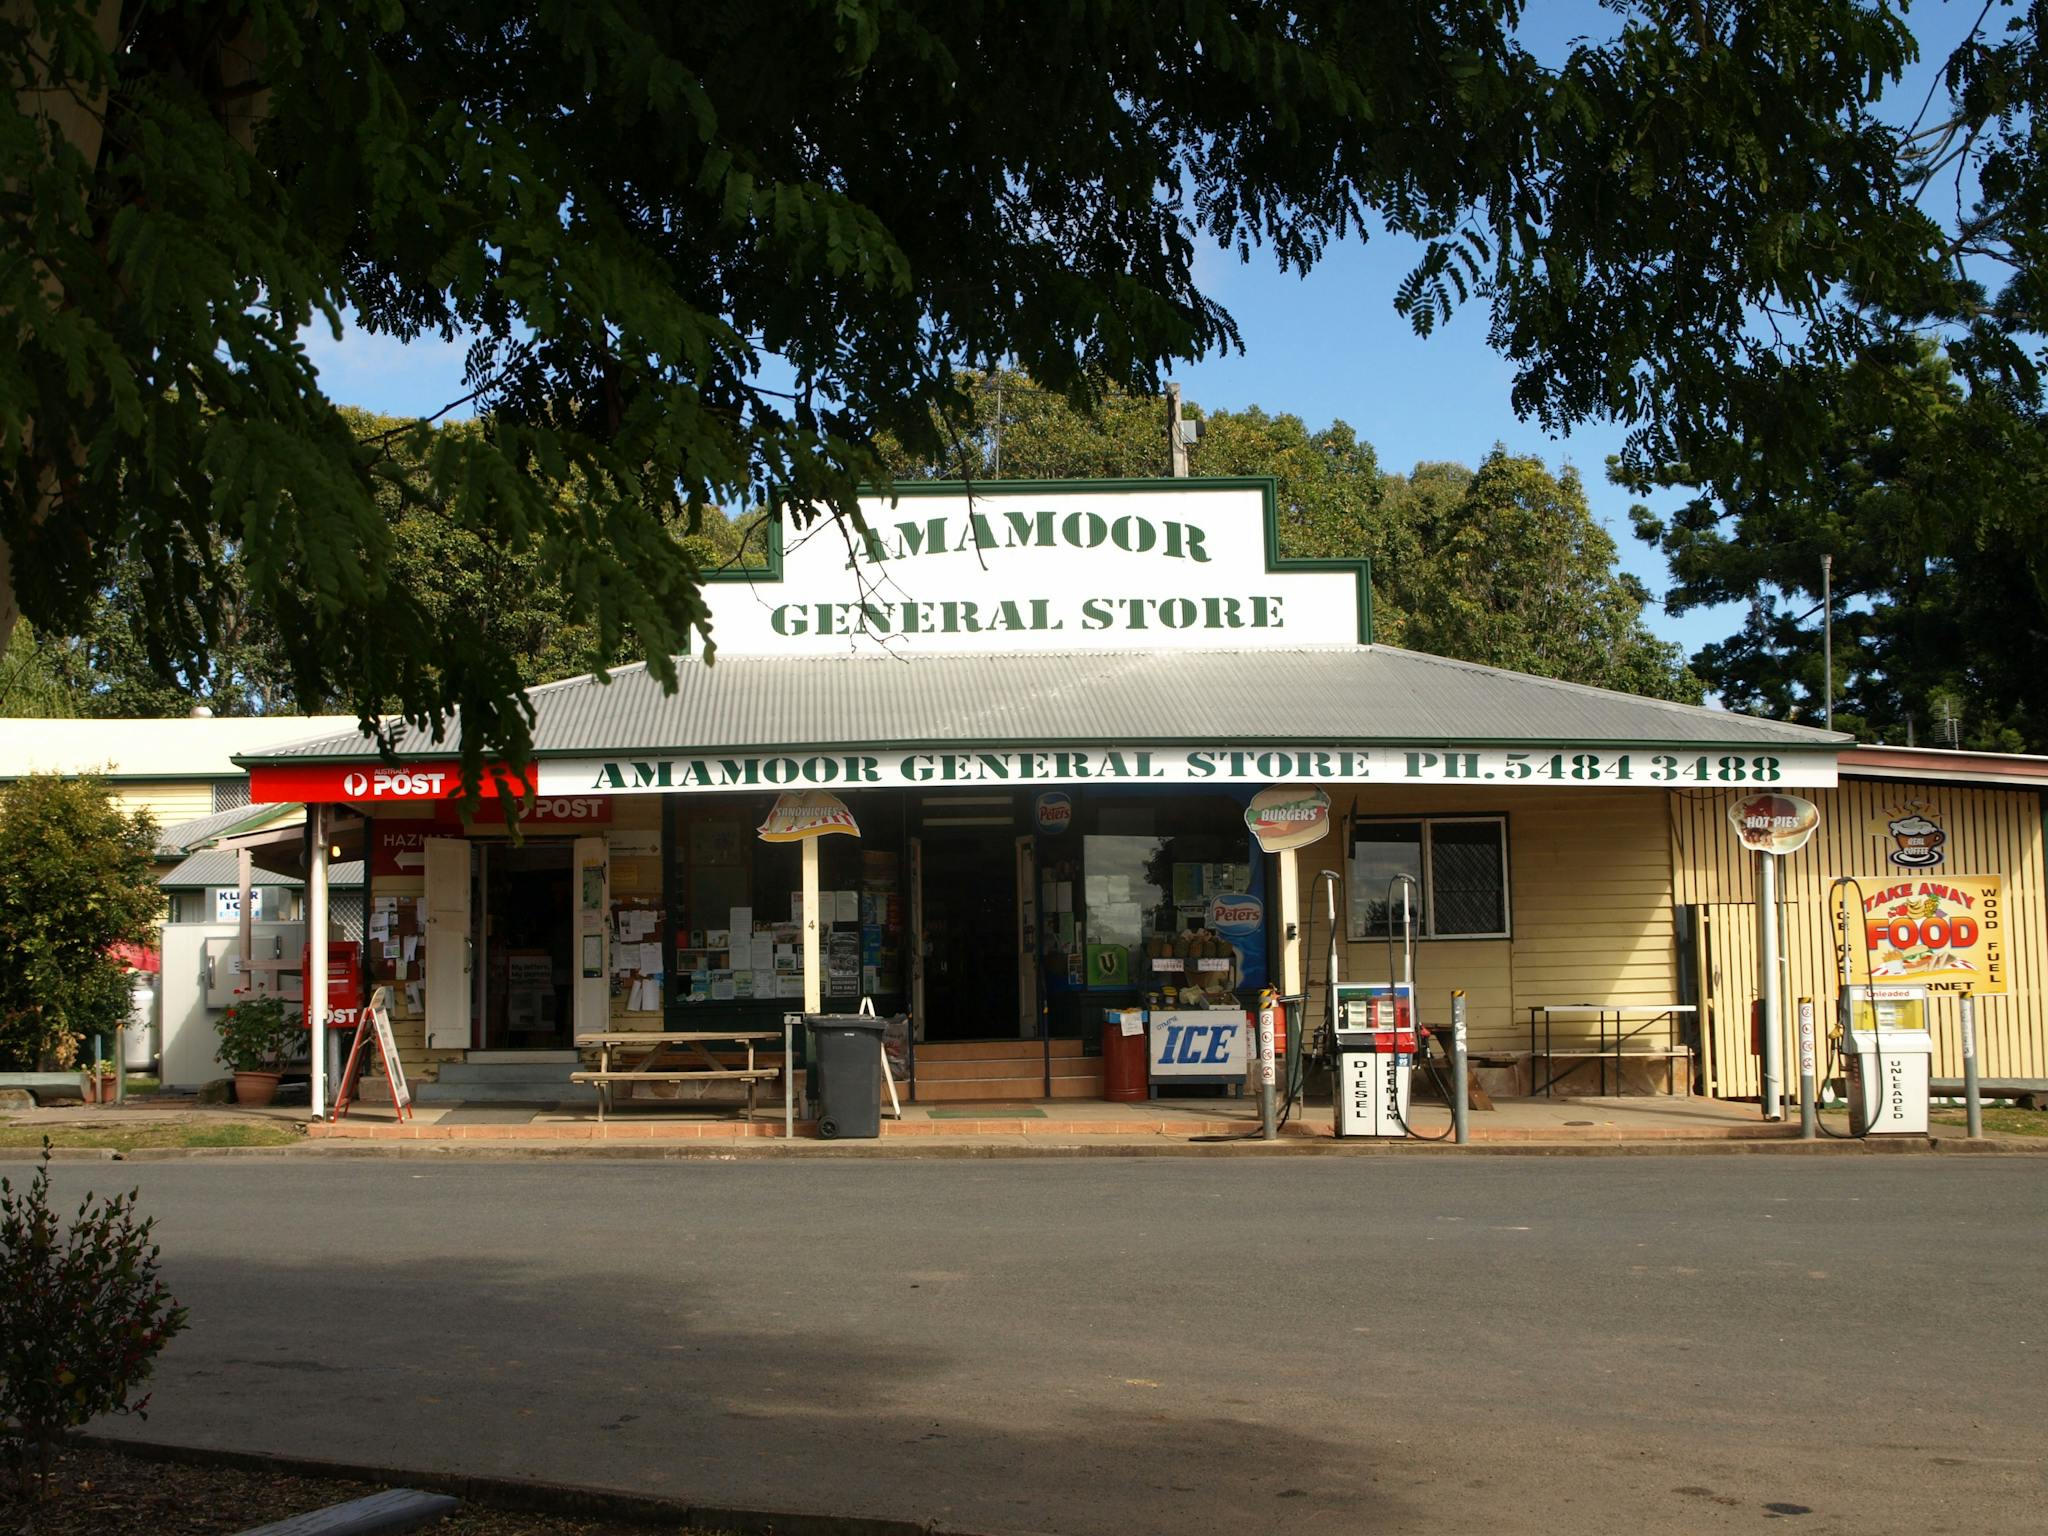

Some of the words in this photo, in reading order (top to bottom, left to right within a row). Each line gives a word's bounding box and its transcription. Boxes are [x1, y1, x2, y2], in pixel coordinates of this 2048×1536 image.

[845, 511, 1212, 571] AMAMOOR
[770, 598, 1063, 636] GENERAL
[1081, 596, 1284, 631] STORE
[591, 756, 882, 789] AMAMOOR
[900, 751, 1164, 782] GENERAL
[1187, 751, 1370, 778] STORE
[1650, 755, 1781, 782] 3488
[373, 773, 445, 795] POST
[536, 800, 603, 819] POST
[777, 807, 839, 817] SANDWICHES
[1040, 806, 1070, 821] Peters
[1261, 807, 1317, 821] BURGERS
[1747, 815, 1770, 828] HOT
[1773, 815, 1800, 828] PIES
[1904, 847, 1929, 855] COFFEE
[1908, 837, 1925, 846] REAL
[219, 891, 258, 900] KLR
[1864, 882, 1913, 913] TAKE
[1919, 882, 1975, 910] AWAY
[1214, 906, 1261, 922] Peters
[1981, 888, 1998, 930] WOOD
[808, 919, 815, 931] 4
[1866, 916, 1979, 951] FOOD
[1101, 953, 1116, 974] V
[1987, 942, 2001, 983] FUEL
[1866, 990, 1910, 998] Unleaded
[1926, 982, 1975, 991] RNET
[1157, 1025, 1238, 1064] ICE
[1353, 1060, 1368, 1119] DIESEL
[1890, 1060, 1904, 1120] UNLEADED
